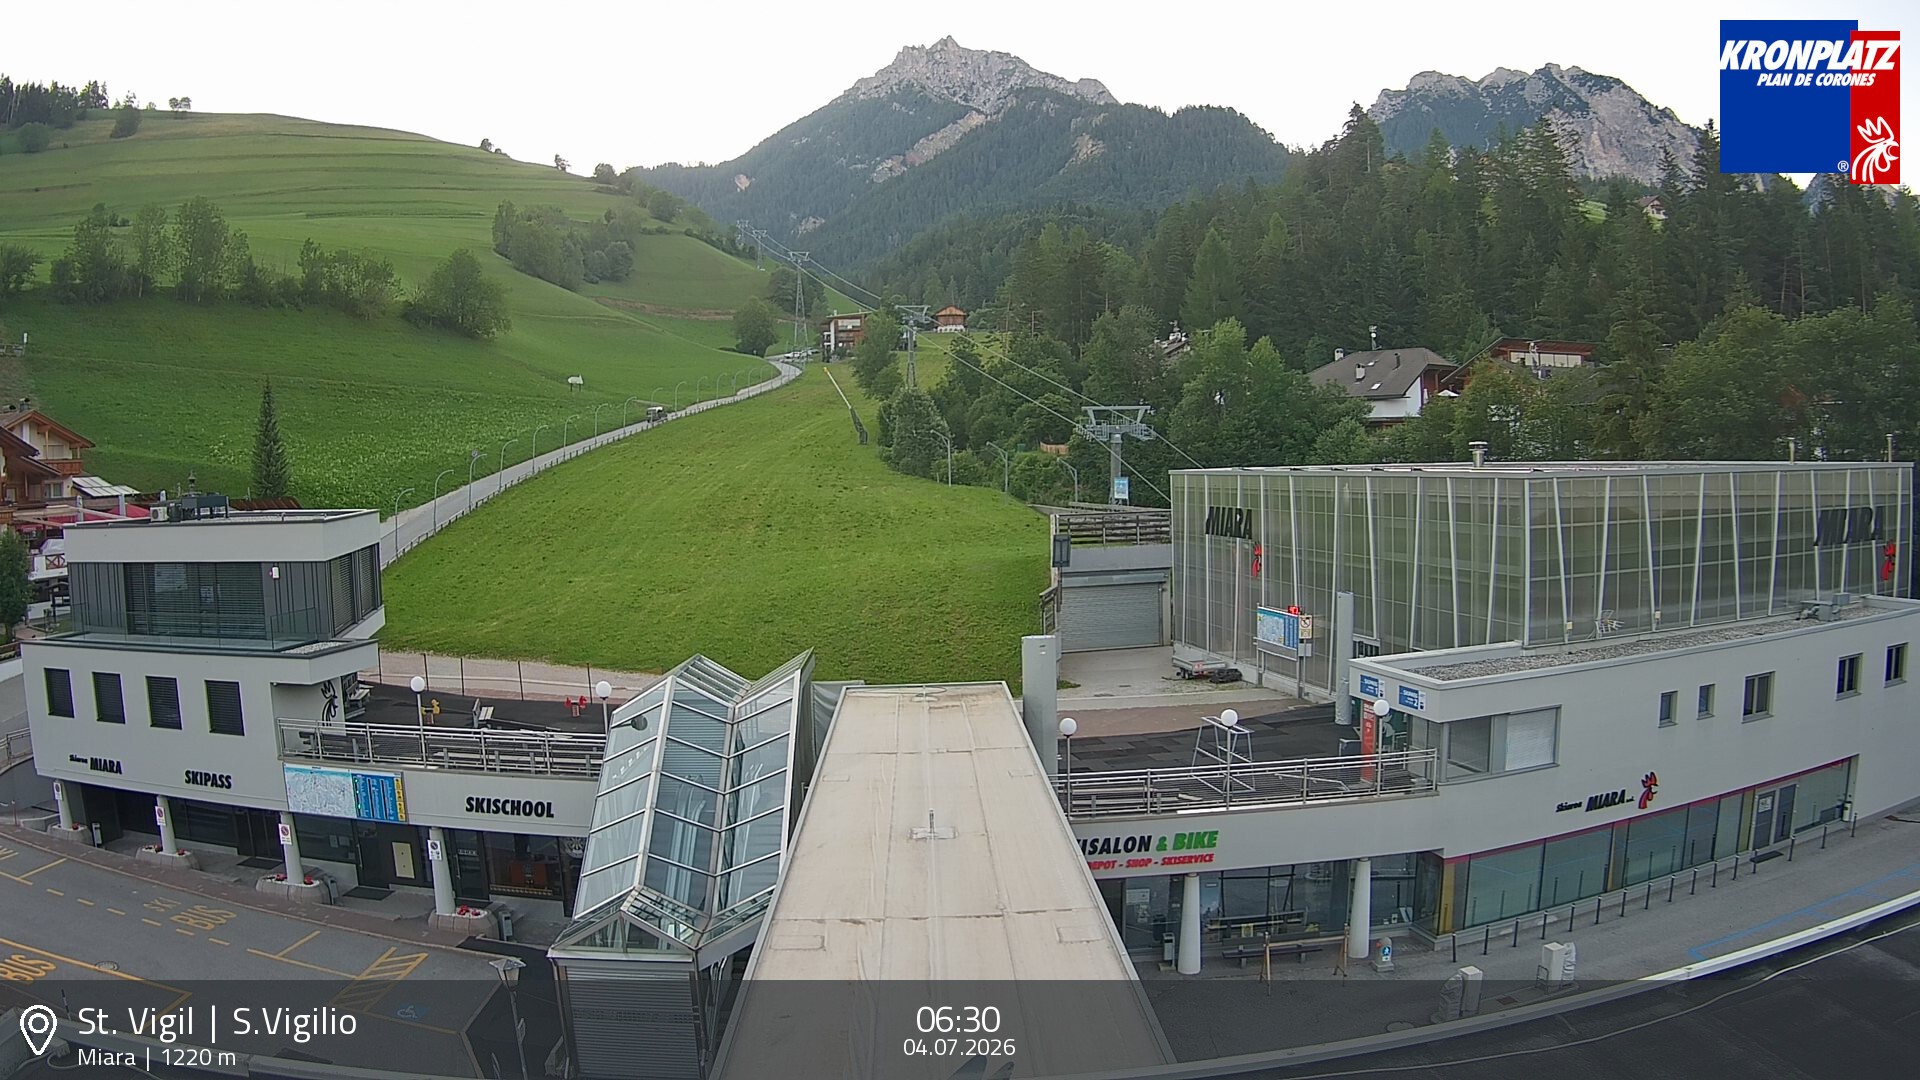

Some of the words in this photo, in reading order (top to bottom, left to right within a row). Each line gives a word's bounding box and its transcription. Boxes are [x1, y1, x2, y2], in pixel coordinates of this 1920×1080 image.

[1205, 505, 1253, 540] MIARA
[1813, 505, 1884, 546] MIARA
[90, 757, 122, 775] MIARA
[184, 769, 232, 789] SKIPASS
[465, 796, 555, 819] SKISCHOOL
[1584, 789, 1626, 812] MIARA
[1077, 835, 1152, 856] ISALON
[1156, 836, 1168, 851] &
[1172, 830, 1219, 851] BIKE
[1125, 858, 1153, 868] SHOP
[1160, 853, 1215, 866] SKISERVICE
[169, 905, 237, 930] BUS
